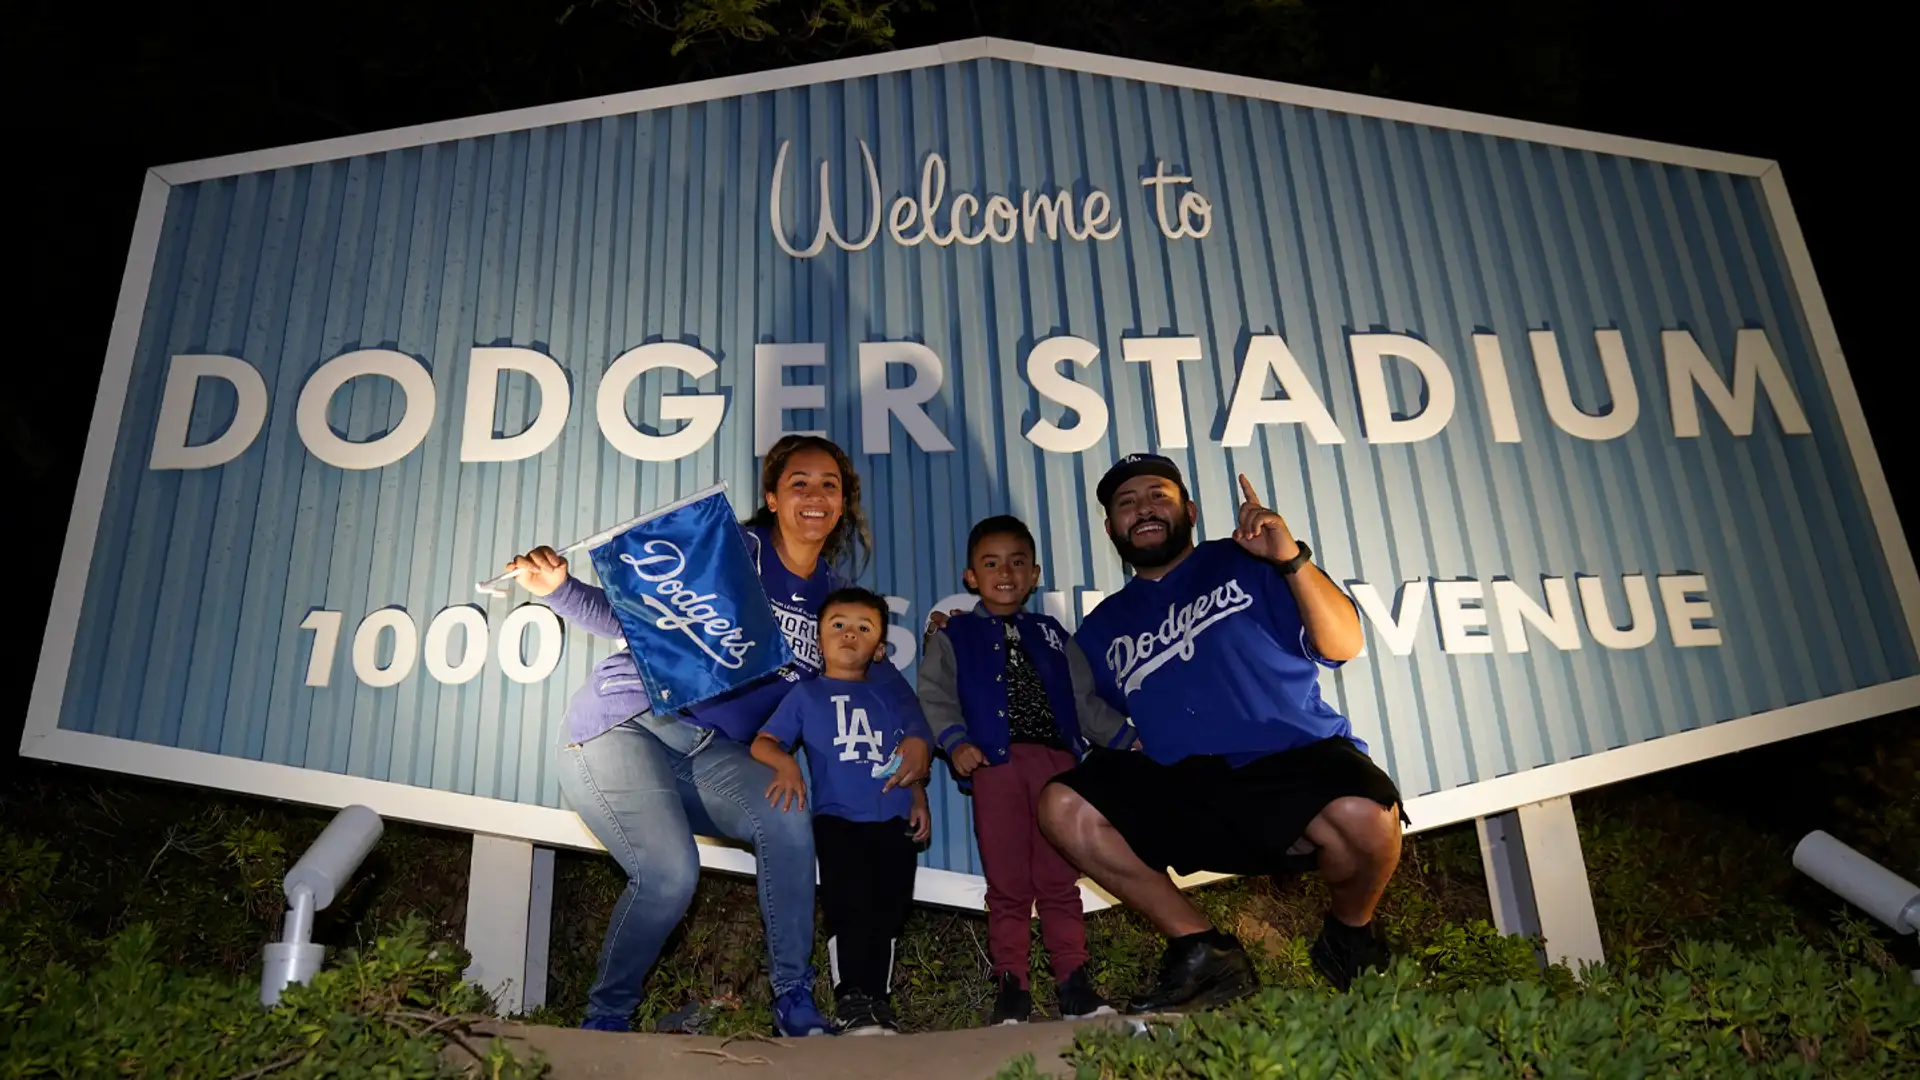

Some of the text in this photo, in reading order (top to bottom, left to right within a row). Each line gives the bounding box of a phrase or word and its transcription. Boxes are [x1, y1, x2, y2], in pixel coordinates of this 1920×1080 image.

[770, 139, 1212, 258] Welcome to
[149, 328, 1811, 471] DODGER STADIUM
[300, 574, 1723, 688] 1000 VENUE
[619, 540, 756, 669] Dodgers
[773, 610, 818, 642] ORL
[1037, 622, 1065, 654] LA
[1106, 579, 1253, 694] Dodgers
[830, 694, 884, 763] LA
